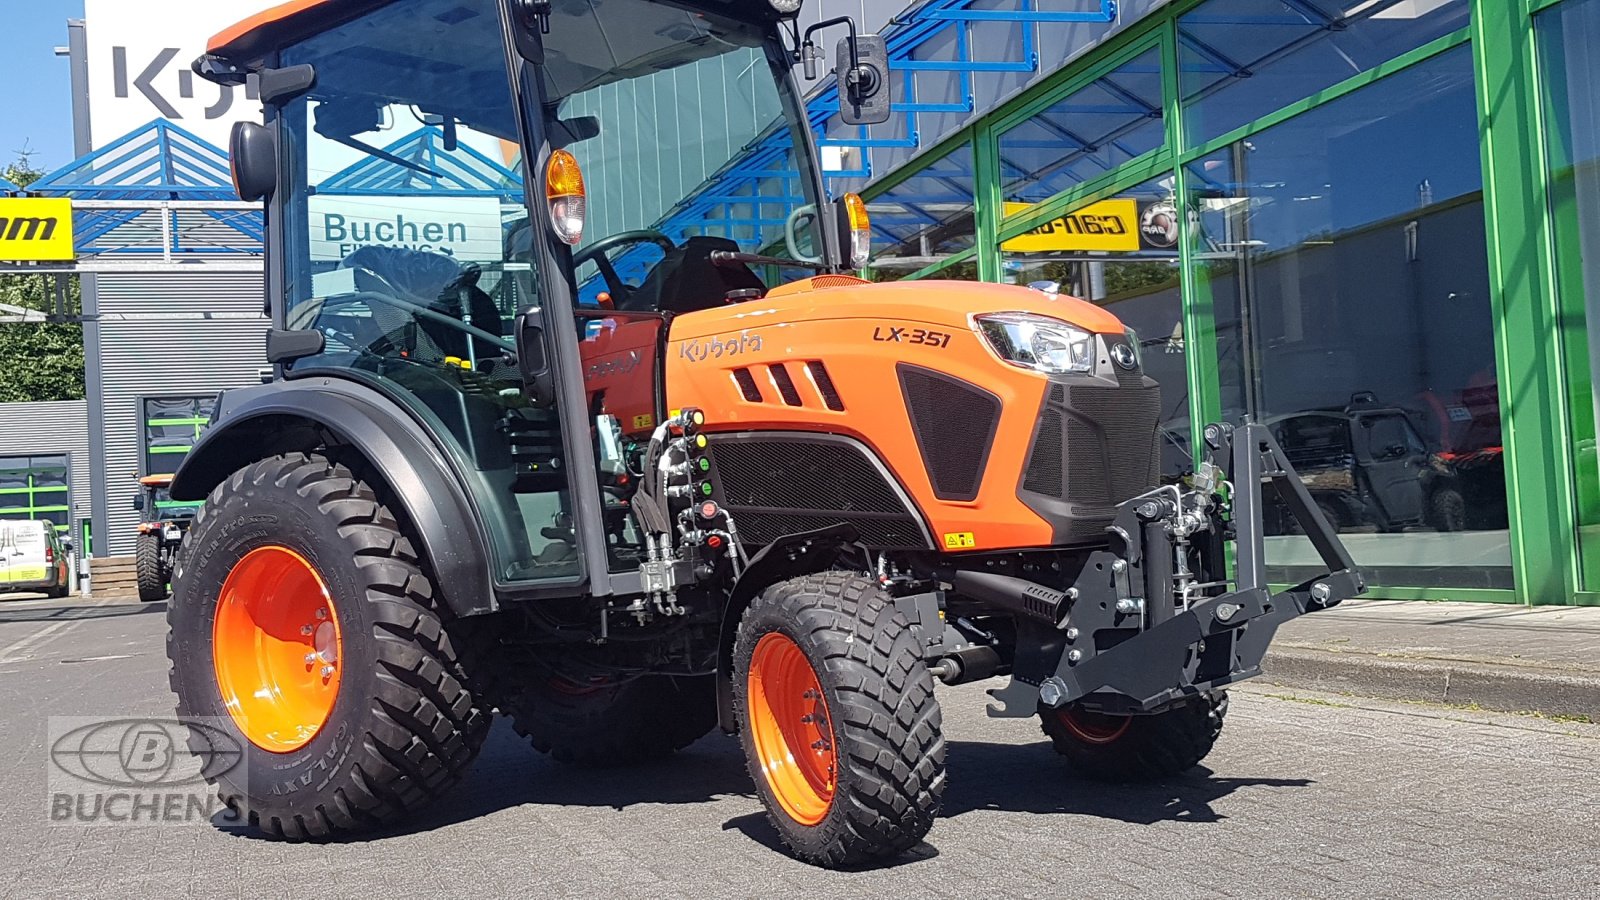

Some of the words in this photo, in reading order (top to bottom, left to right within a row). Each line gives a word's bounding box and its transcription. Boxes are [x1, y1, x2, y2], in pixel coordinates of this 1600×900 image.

[324, 213, 467, 242] Buchen
[680, 331, 763, 362] Kubota
[873, 327, 951, 348] LX-351
[188, 515, 245, 603] rden-Pro
